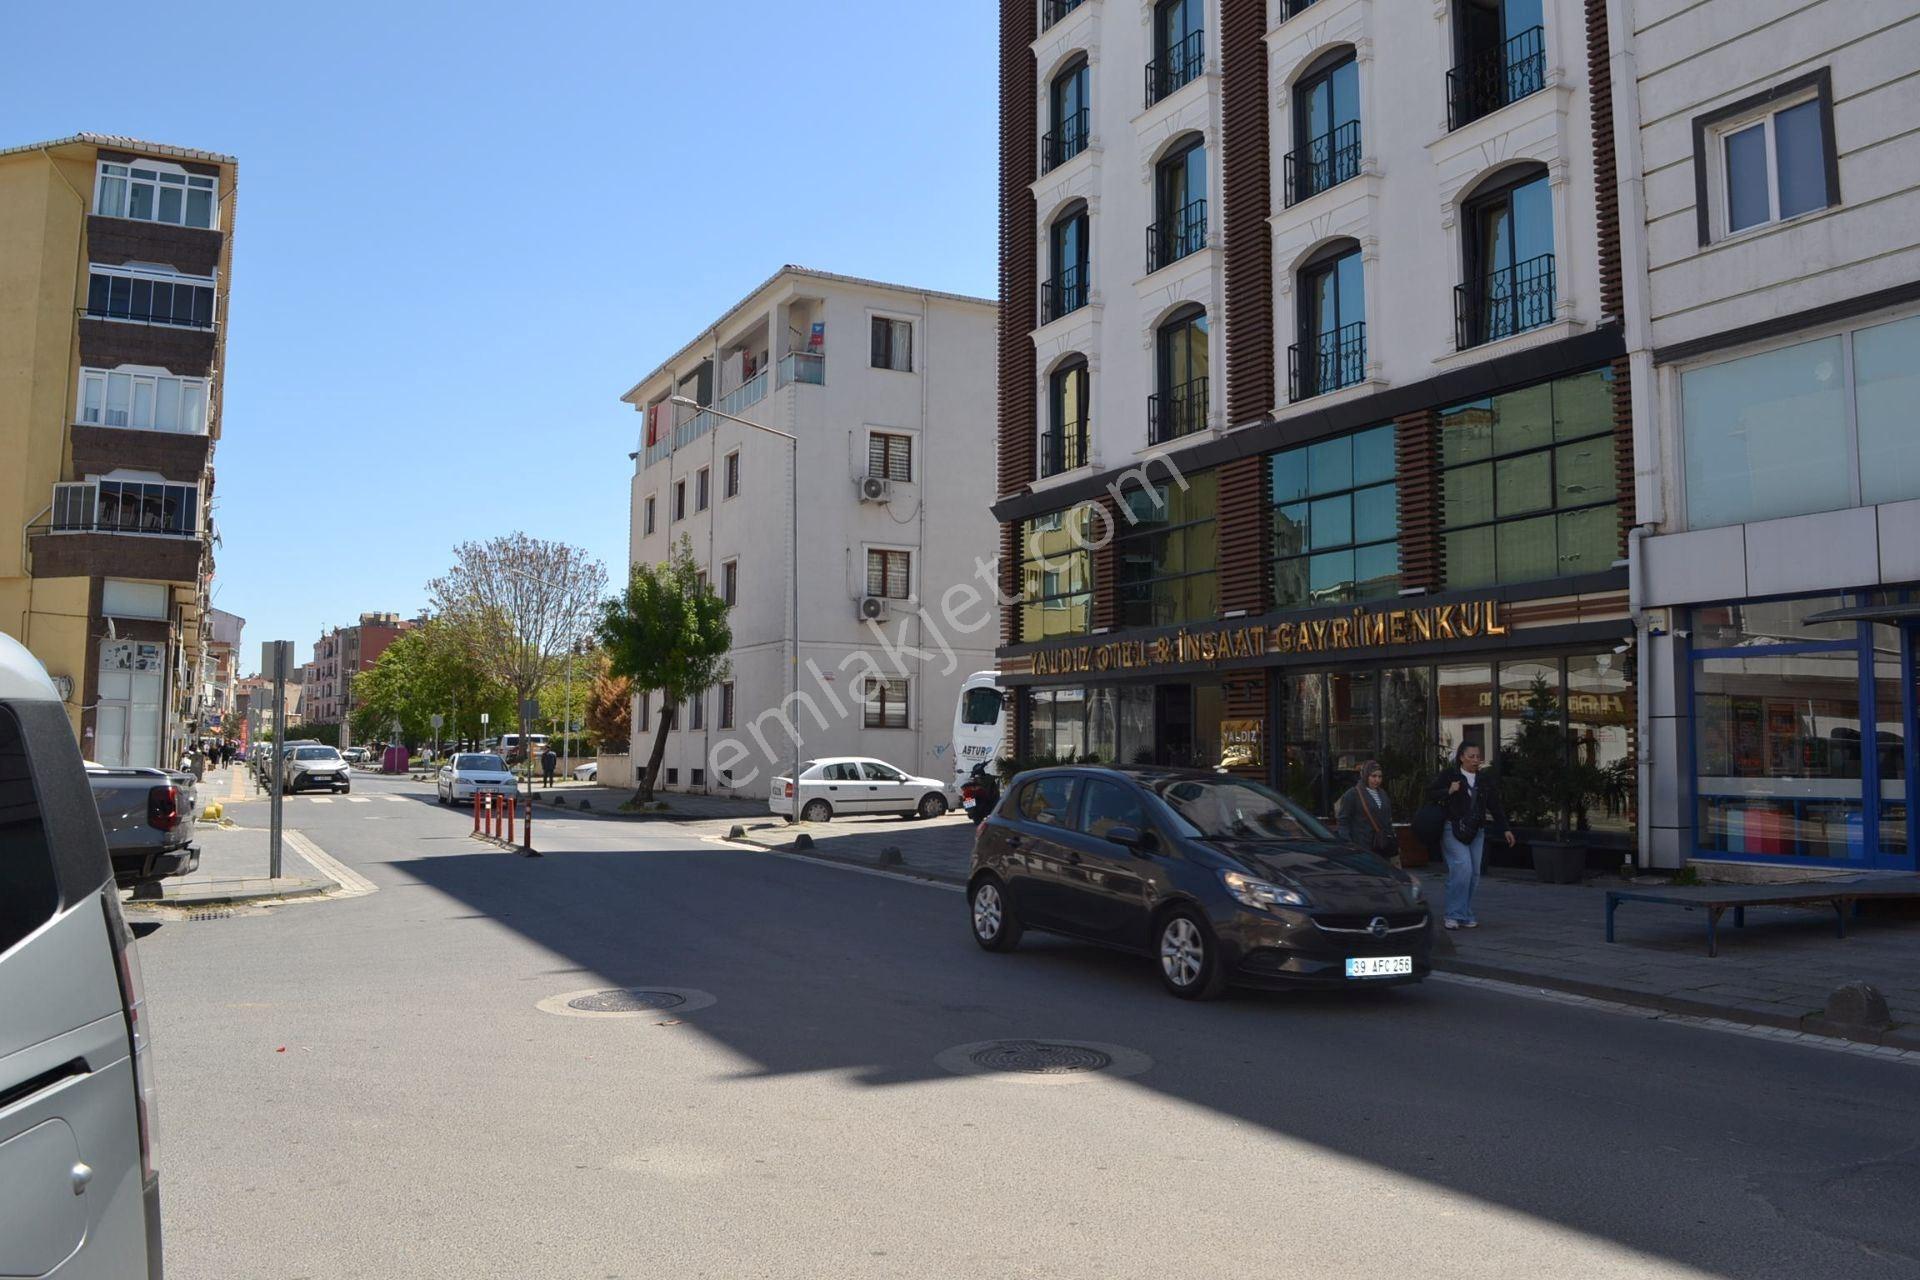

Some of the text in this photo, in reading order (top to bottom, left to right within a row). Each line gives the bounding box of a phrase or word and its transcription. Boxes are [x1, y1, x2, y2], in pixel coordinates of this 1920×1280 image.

[1031, 600, 1506, 675] YALDIZ OTEL & İNŞAAT GAYRİMENKUL
[1223, 730, 1257, 743] YALDIZ
[1353, 958, 1410, 973] 39 AFC 256
